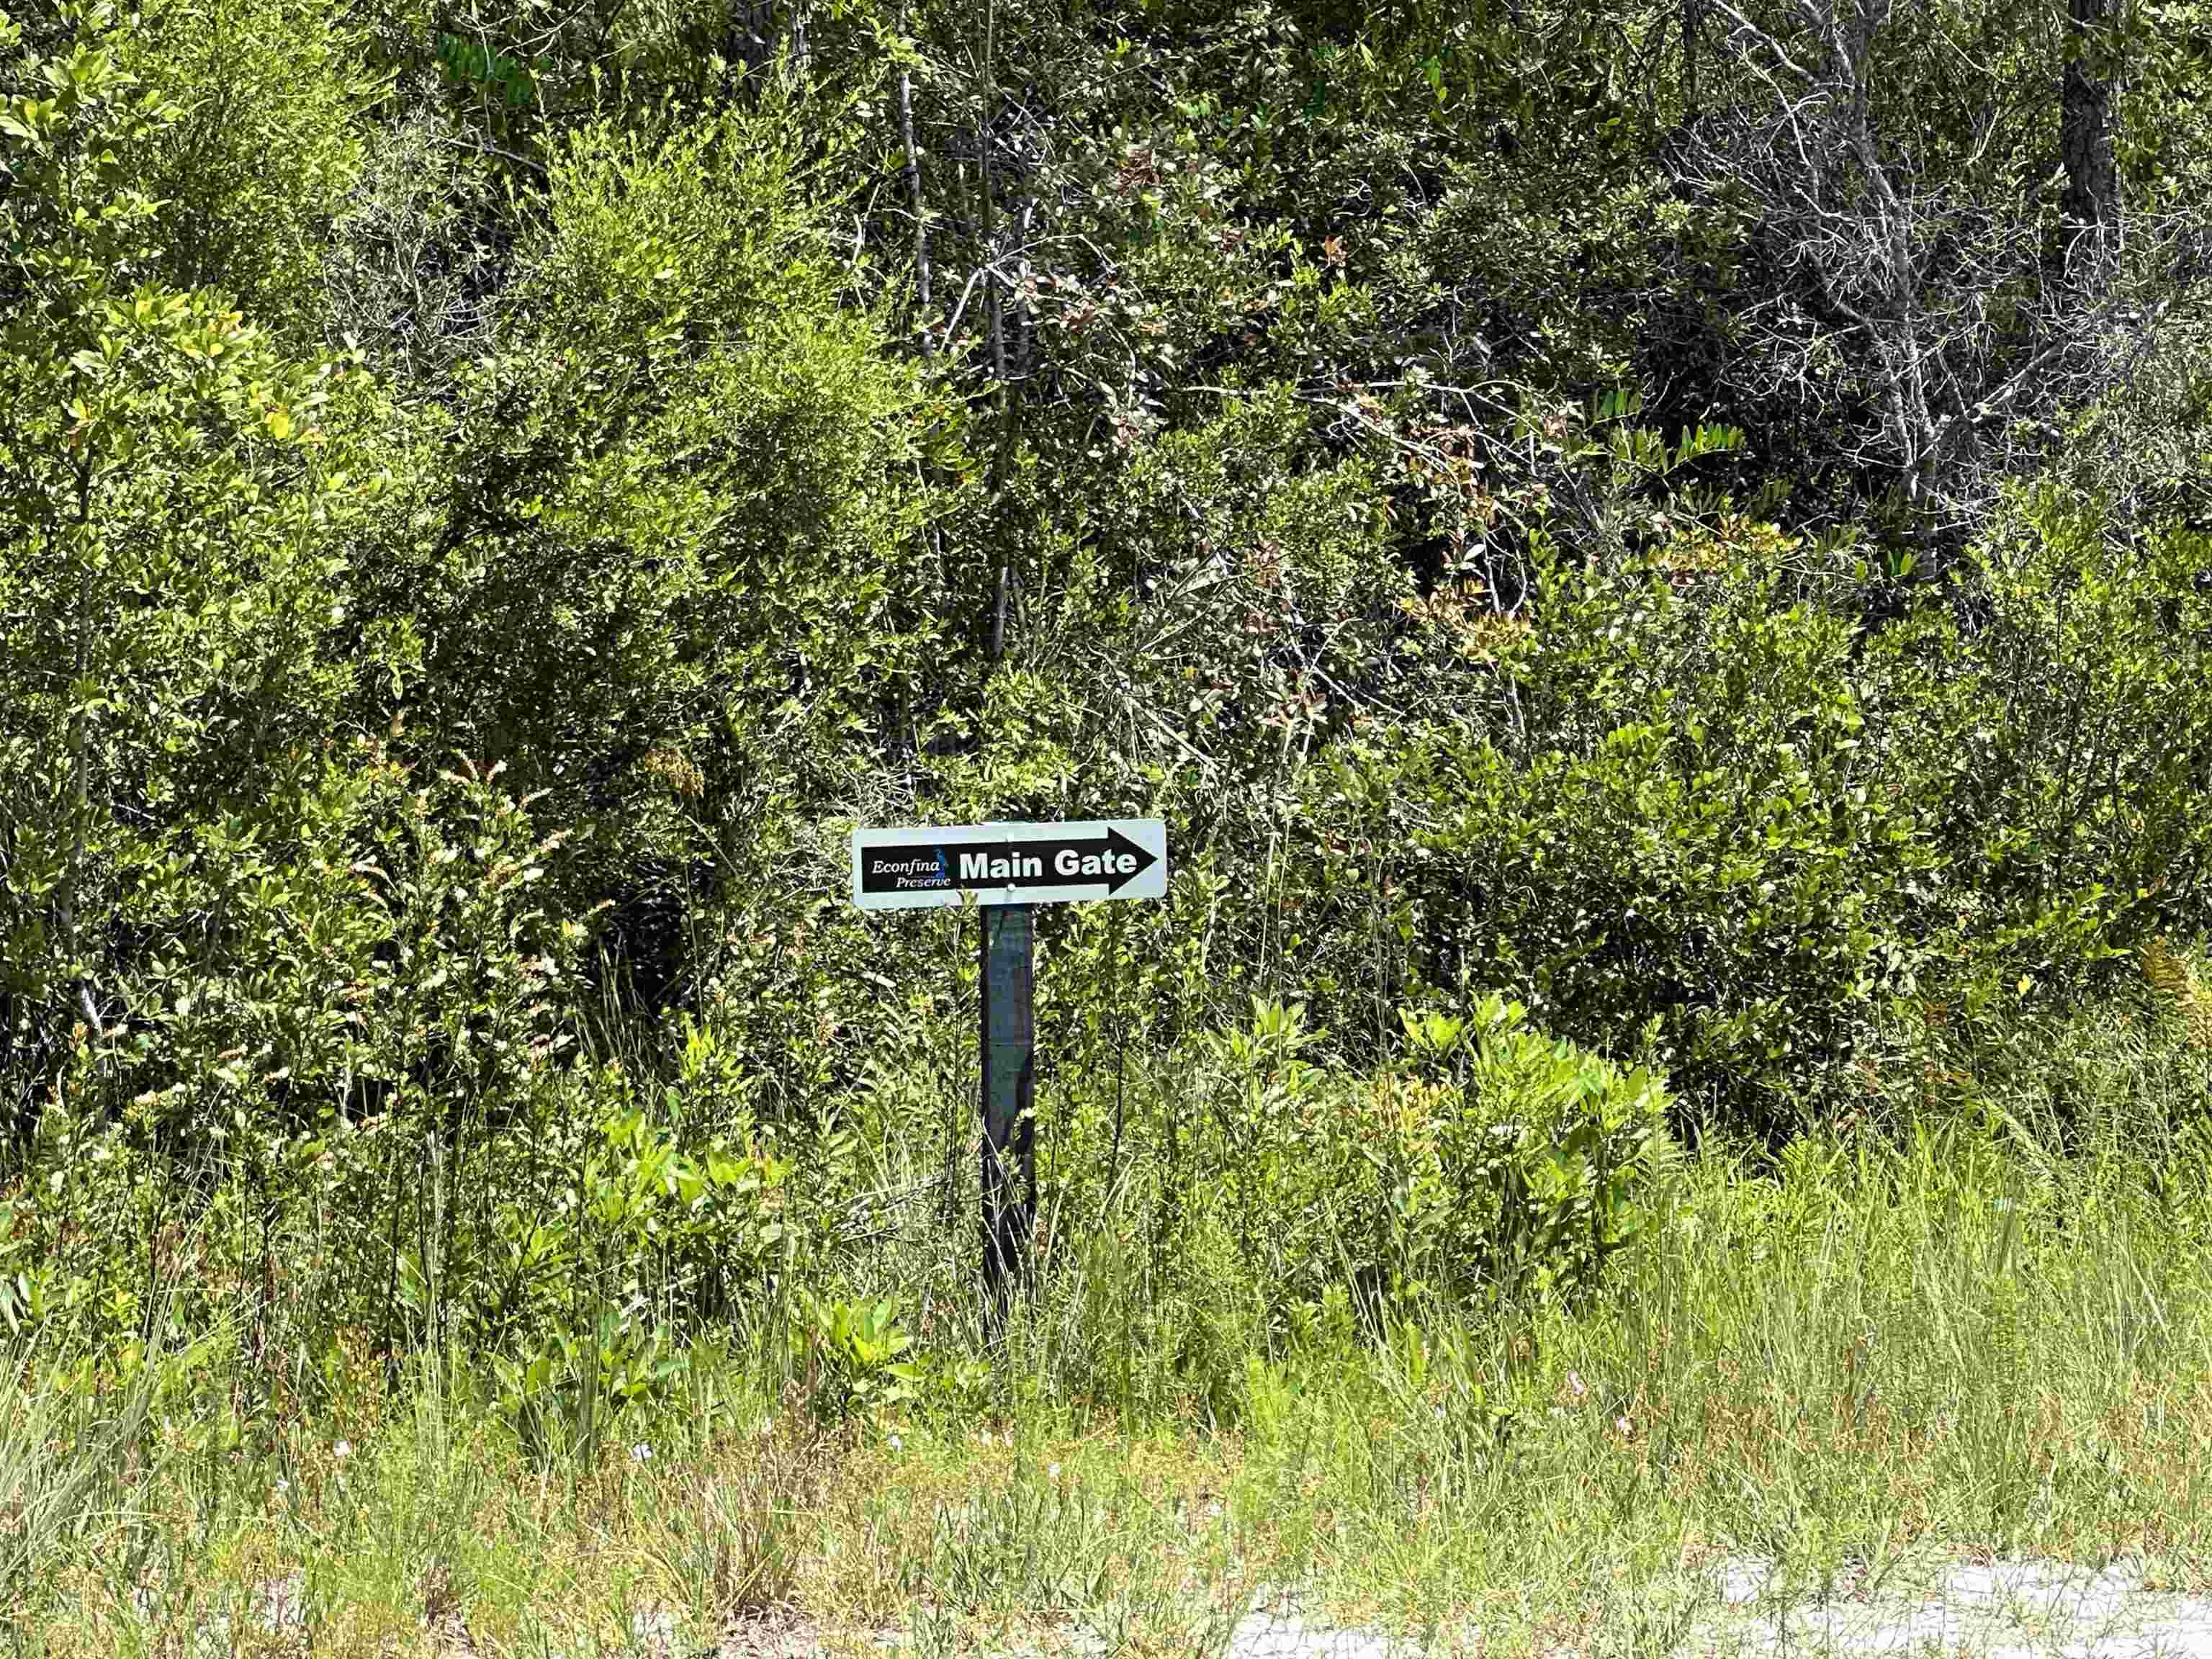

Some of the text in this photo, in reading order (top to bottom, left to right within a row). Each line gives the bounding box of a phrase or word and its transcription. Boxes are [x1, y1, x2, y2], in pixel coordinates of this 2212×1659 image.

[872, 859, 940, 876] Econfina
[960, 849, 1137, 880] Main Gate
[896, 877, 950, 888] Preserve
